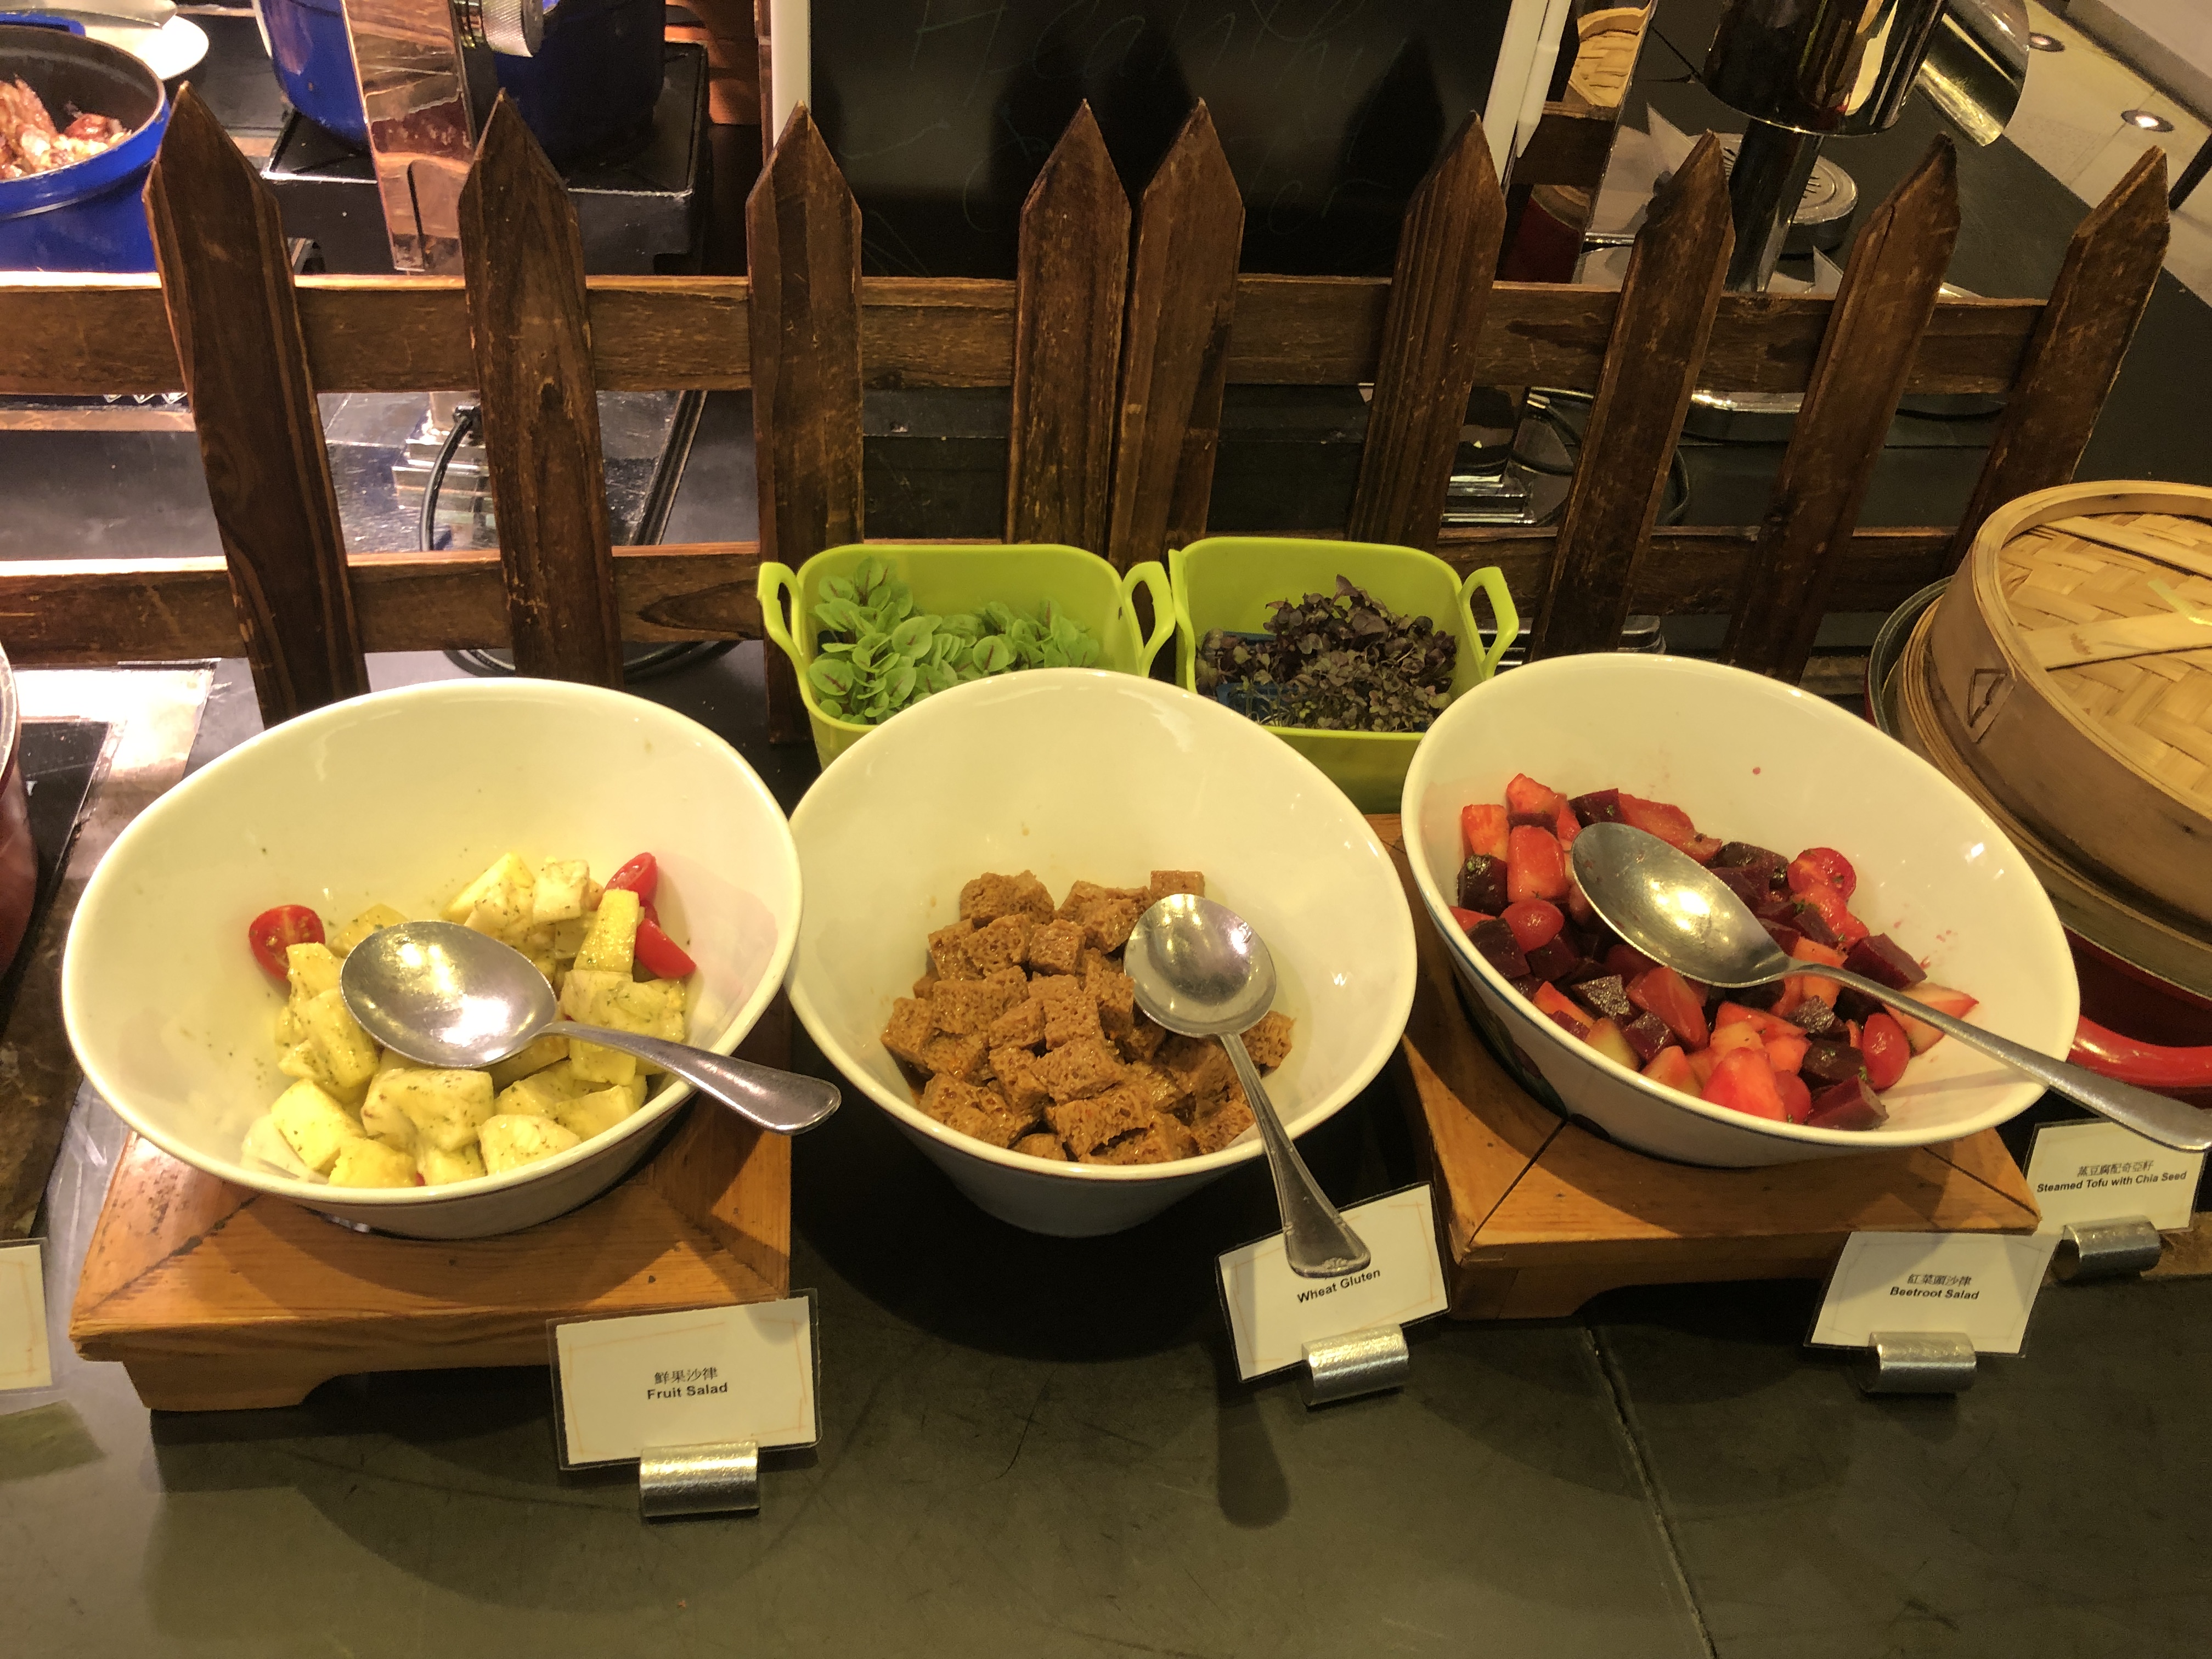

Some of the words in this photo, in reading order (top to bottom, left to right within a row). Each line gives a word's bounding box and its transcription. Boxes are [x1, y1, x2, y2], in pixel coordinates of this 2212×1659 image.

[2037, 1180, 2083, 1193] Steamed
[2086, 1178, 2108, 1188] Tofu
[2111, 1176, 2132, 1186] with
[2135, 1173, 2158, 1184] Chia
[2162, 1171, 2187, 1182] Seed
[1297, 1283, 1338, 1304] Wheat
[1340, 1269, 1381, 1289] Gluten
[1890, 1286, 1942, 1297] Beetroot
[1945, 1289, 1980, 1300] Salad
[654, 1367, 718, 1385] 鮮果沙律
[647, 1387, 682, 1400] Fruit
[686, 1381, 728, 1396] Salad
